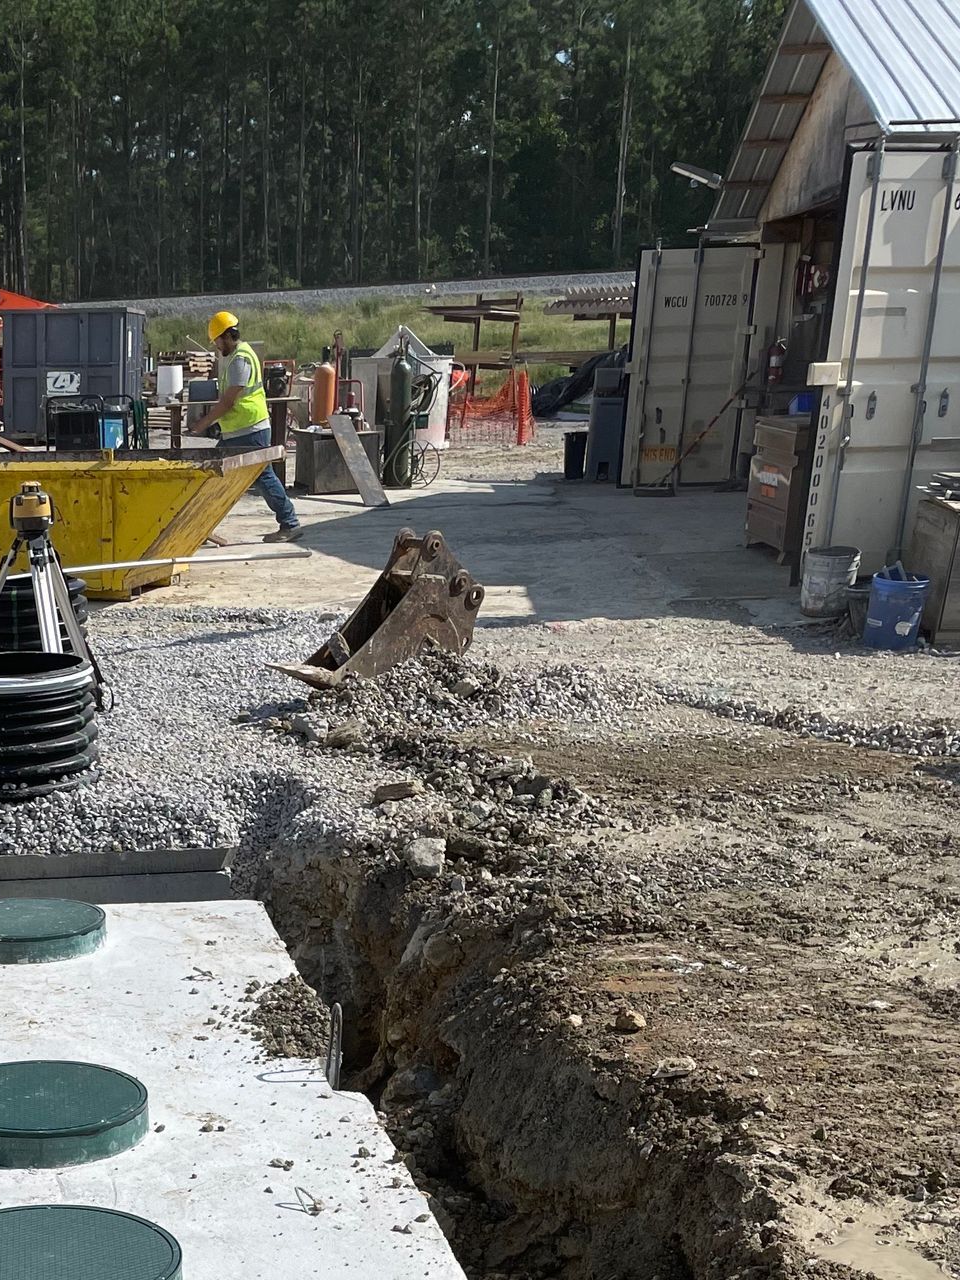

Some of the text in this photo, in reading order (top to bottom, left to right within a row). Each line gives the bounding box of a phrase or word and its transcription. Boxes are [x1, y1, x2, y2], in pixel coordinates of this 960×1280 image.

[880, 190, 916, 211] LVNU
[664, 296, 688, 308] WGCU
[704, 294, 738, 306] 700728
